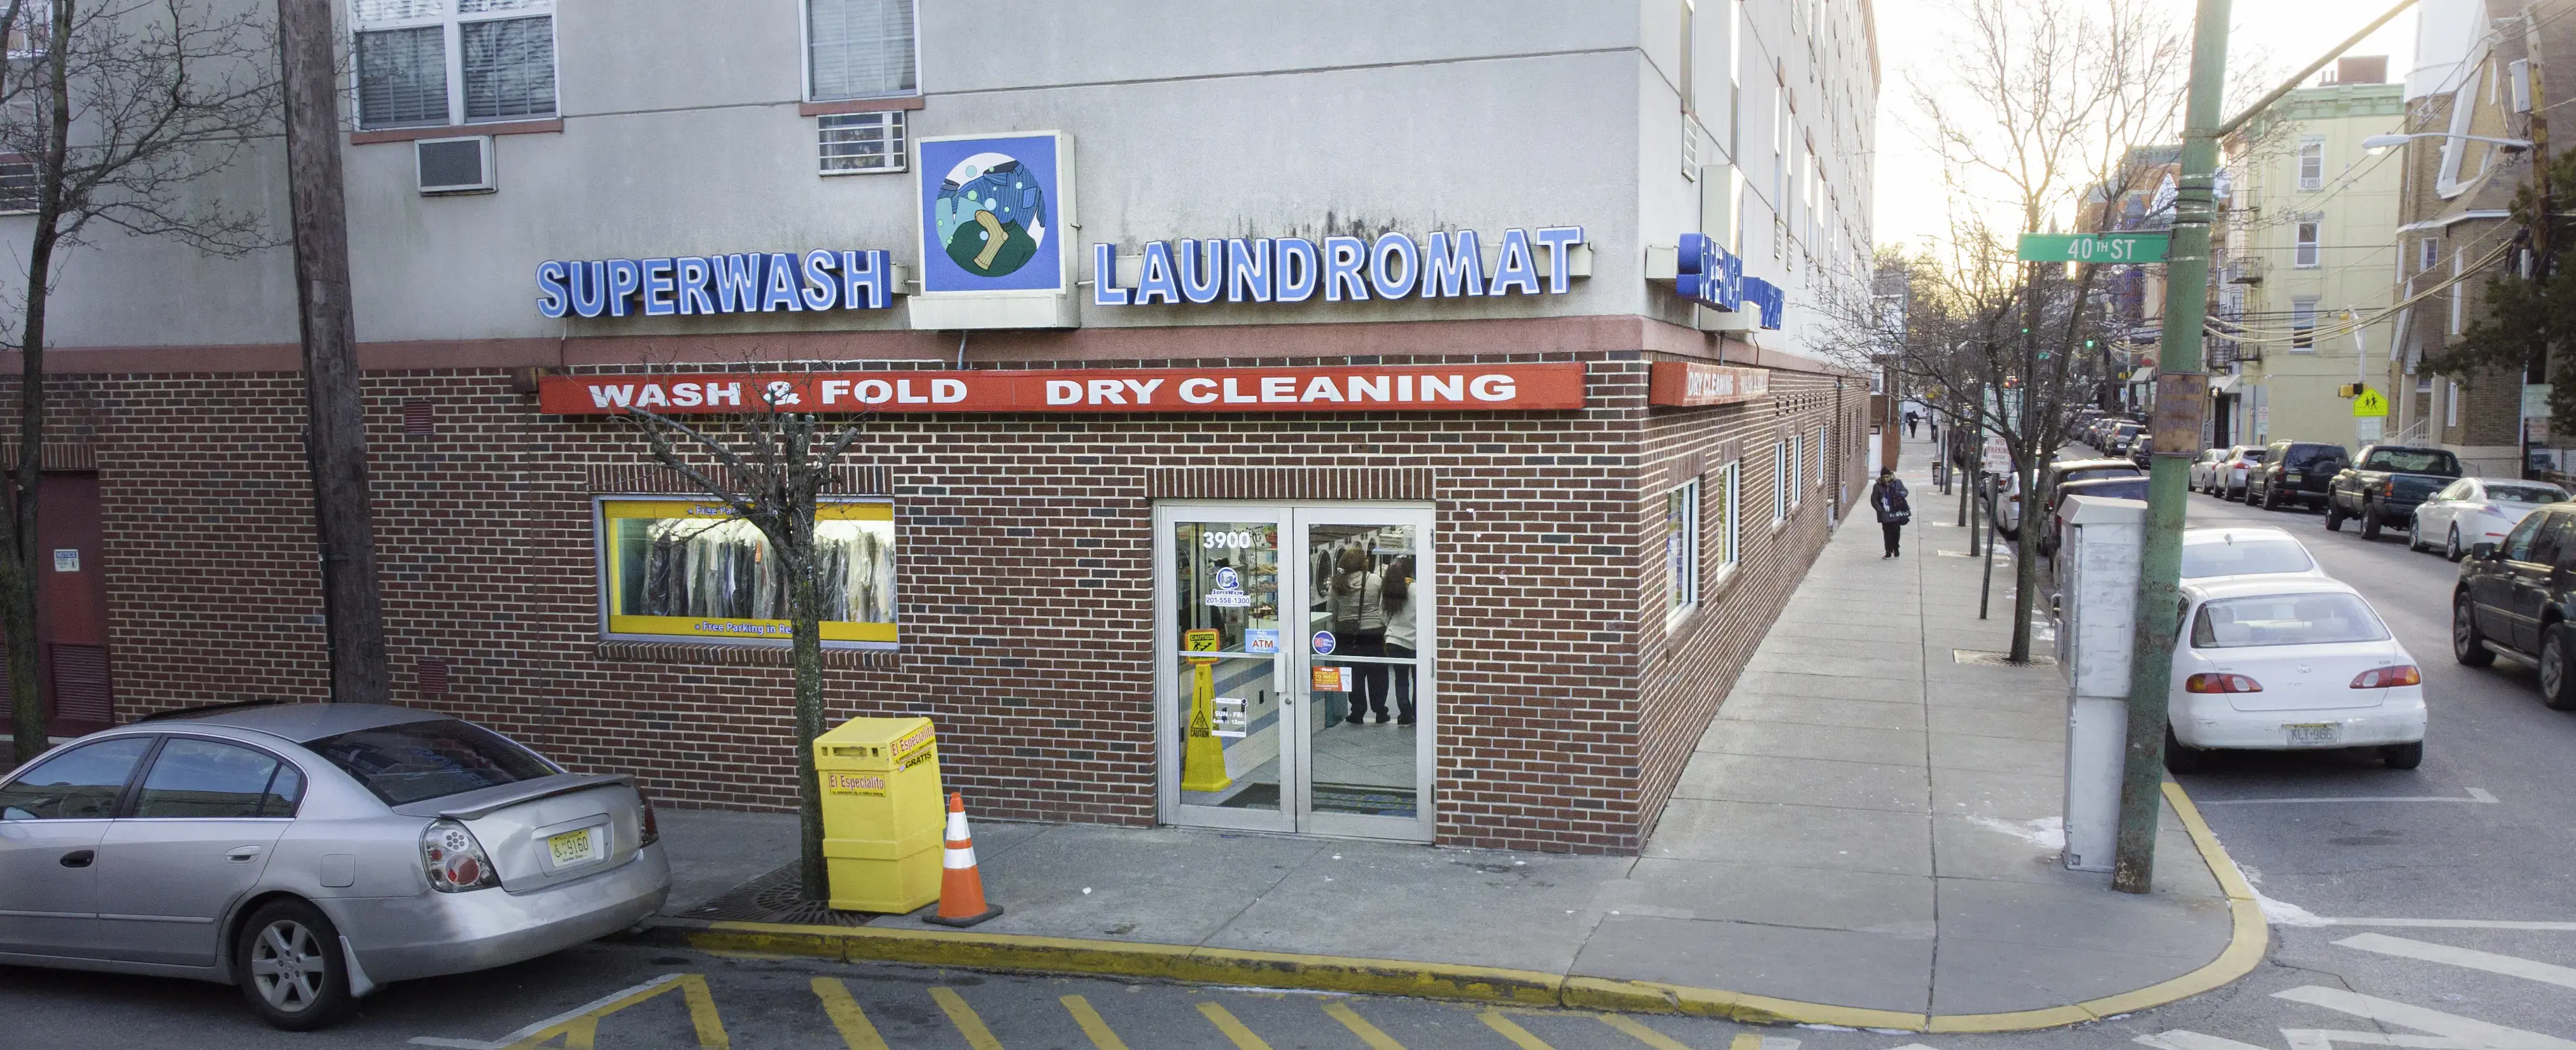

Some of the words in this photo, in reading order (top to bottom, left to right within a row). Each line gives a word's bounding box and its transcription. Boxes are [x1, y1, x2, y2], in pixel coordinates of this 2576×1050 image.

[2111, 238, 2136, 260] ST
[1093, 226, 1584, 306] LAUNDROMAT
[535, 248, 886, 319] SUPERWASH
[588, 381, 741, 409] WASH
[763, 380, 801, 405] &
[822, 379, 968, 405] FOLD
[1046, 379, 1164, 406] DRY
[1179, 374, 1517, 405] CLEANING
[1688, 371, 1704, 396] DRY
[1704, 372, 1733, 396] CLEANING
[1203, 531, 1250, 549] 3900
[703, 622, 724, 631] Free
[727, 622, 764, 635] Parking
[767, 624, 776, 633] in
[779, 624, 792, 634] Re
[1252, 640, 1273, 648] ATM
[892, 742, 899, 757] El
[899, 724, 934, 752] Especialito
[1191, 729, 1209, 738] CAUTION
[906, 752, 931, 768] GRATIS
[830, 774, 838, 788] El
[840, 774, 884, 790] Especialito
[566, 836, 589, 855] 9160
